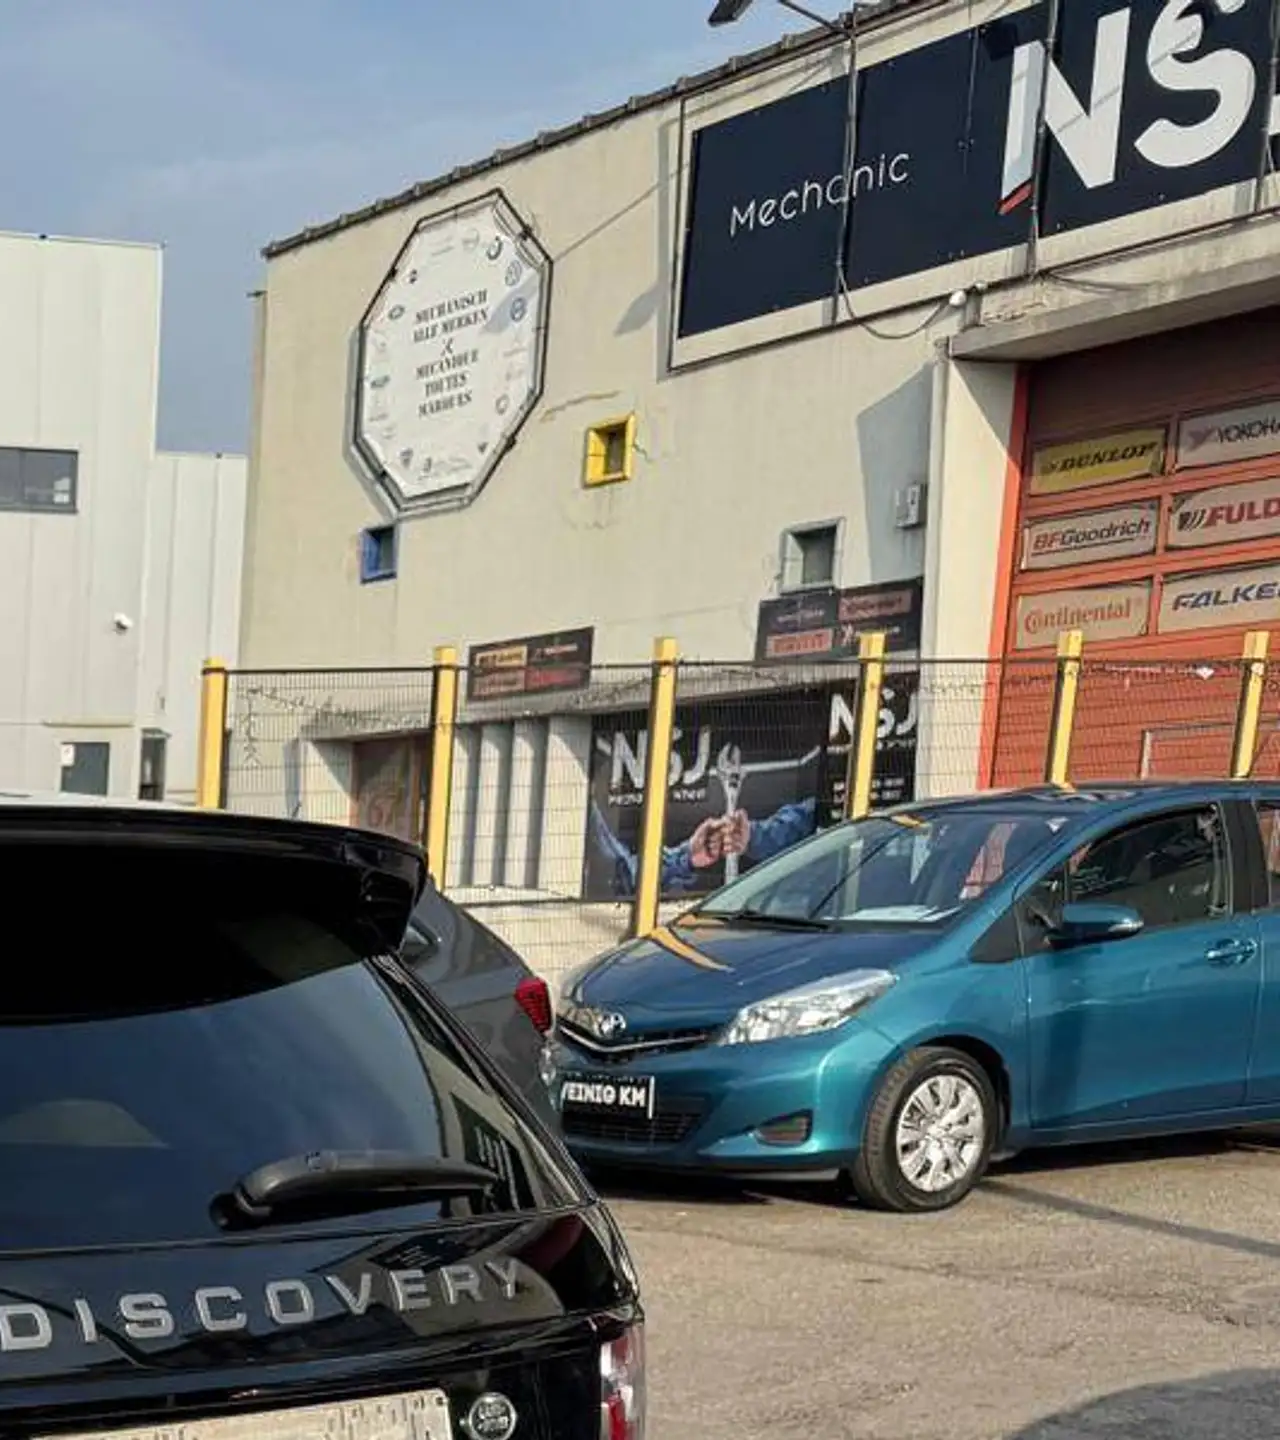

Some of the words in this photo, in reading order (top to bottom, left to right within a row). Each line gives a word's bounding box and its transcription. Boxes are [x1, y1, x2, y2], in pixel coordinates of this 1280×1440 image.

[999, 0, 1280, 214] NS
[730, 152, 910, 238] Mechanic
[1059, 442, 1158, 472] DUNLOP
[1032, 517, 1150, 552] BFGoodrich
[1024, 599, 1131, 634] Continental
[619, 1085, 646, 1108] KM
